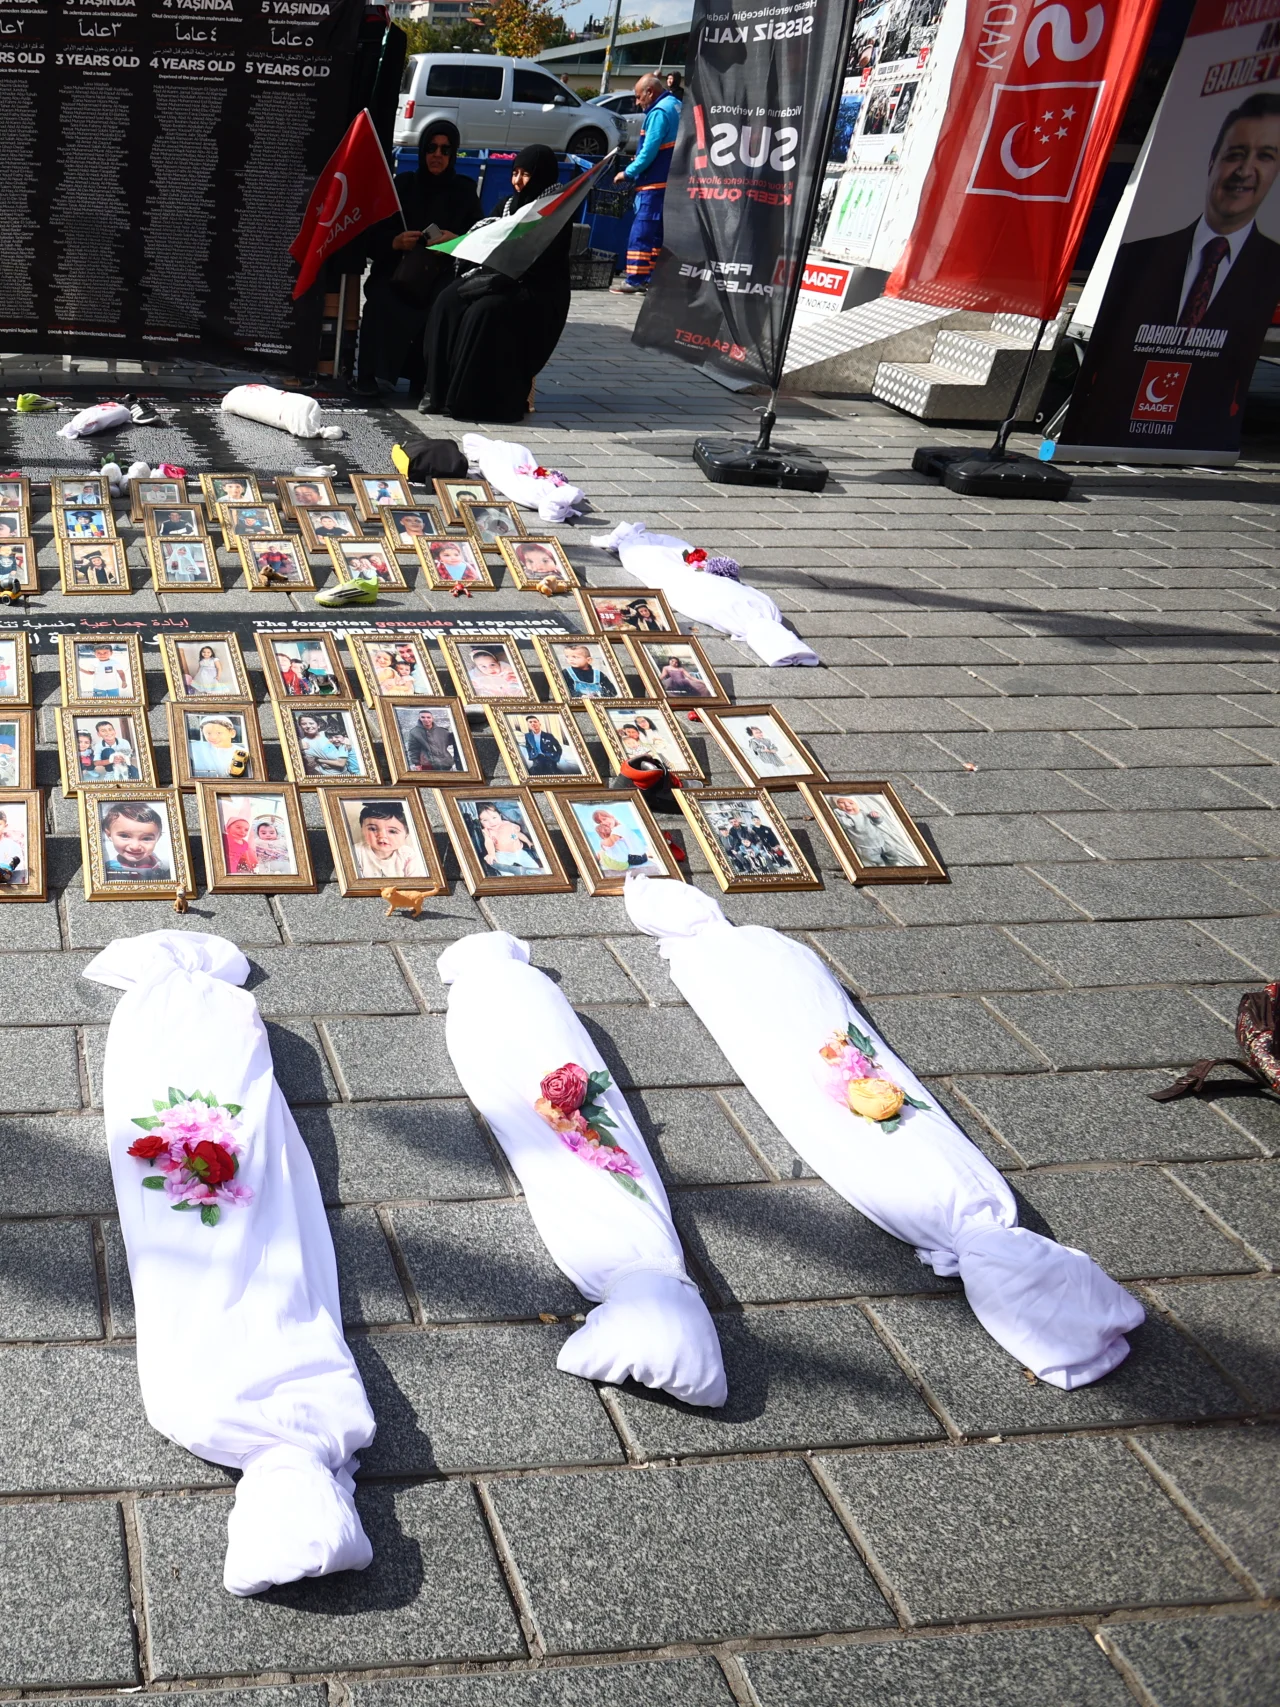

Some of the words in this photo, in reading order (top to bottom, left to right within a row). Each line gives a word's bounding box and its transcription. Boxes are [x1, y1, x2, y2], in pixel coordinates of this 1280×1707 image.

[176, 0, 234, 12] YAŞINDA
[261, 1, 270, 13] 5
[273, 1, 330, 16] YAŞINDA
[17, 52, 45, 64] OLD
[55, 54, 64, 65] 3
[66, 54, 110, 66] YEARS
[112, 55, 140, 67] OLD
[149, 57, 159, 69] 4
[161, 57, 205, 70] YEARS
[207, 60, 235, 72] OLD
[245, 62, 253, 73] 5
[256, 62, 300, 76] YEARS
[302, 66, 330, 77] OLD
[1203, 55, 1274, 94] SAADET
[802, 270, 843, 289] AADET
[1134, 324, 1188, 345] MAHMUT
[1184, 327, 1228, 349] ARIKAN
[1133, 344, 1155, 352] Saadet
[1155, 346, 1175, 354] Partisi
[1176, 347, 1194, 356] Genel
[1195, 350, 1220, 359] Başkanı
[1138, 403, 1174, 413] SAADET
[1129, 420, 1174, 435] ÜSKÜDAR
[80, 618, 147, 628] جماعية
[151, 618, 189, 628] إبادة
[291, 620, 372, 628] forgotten
[375, 620, 454, 628] genocide
[476, 619, 559, 627] repeated!
